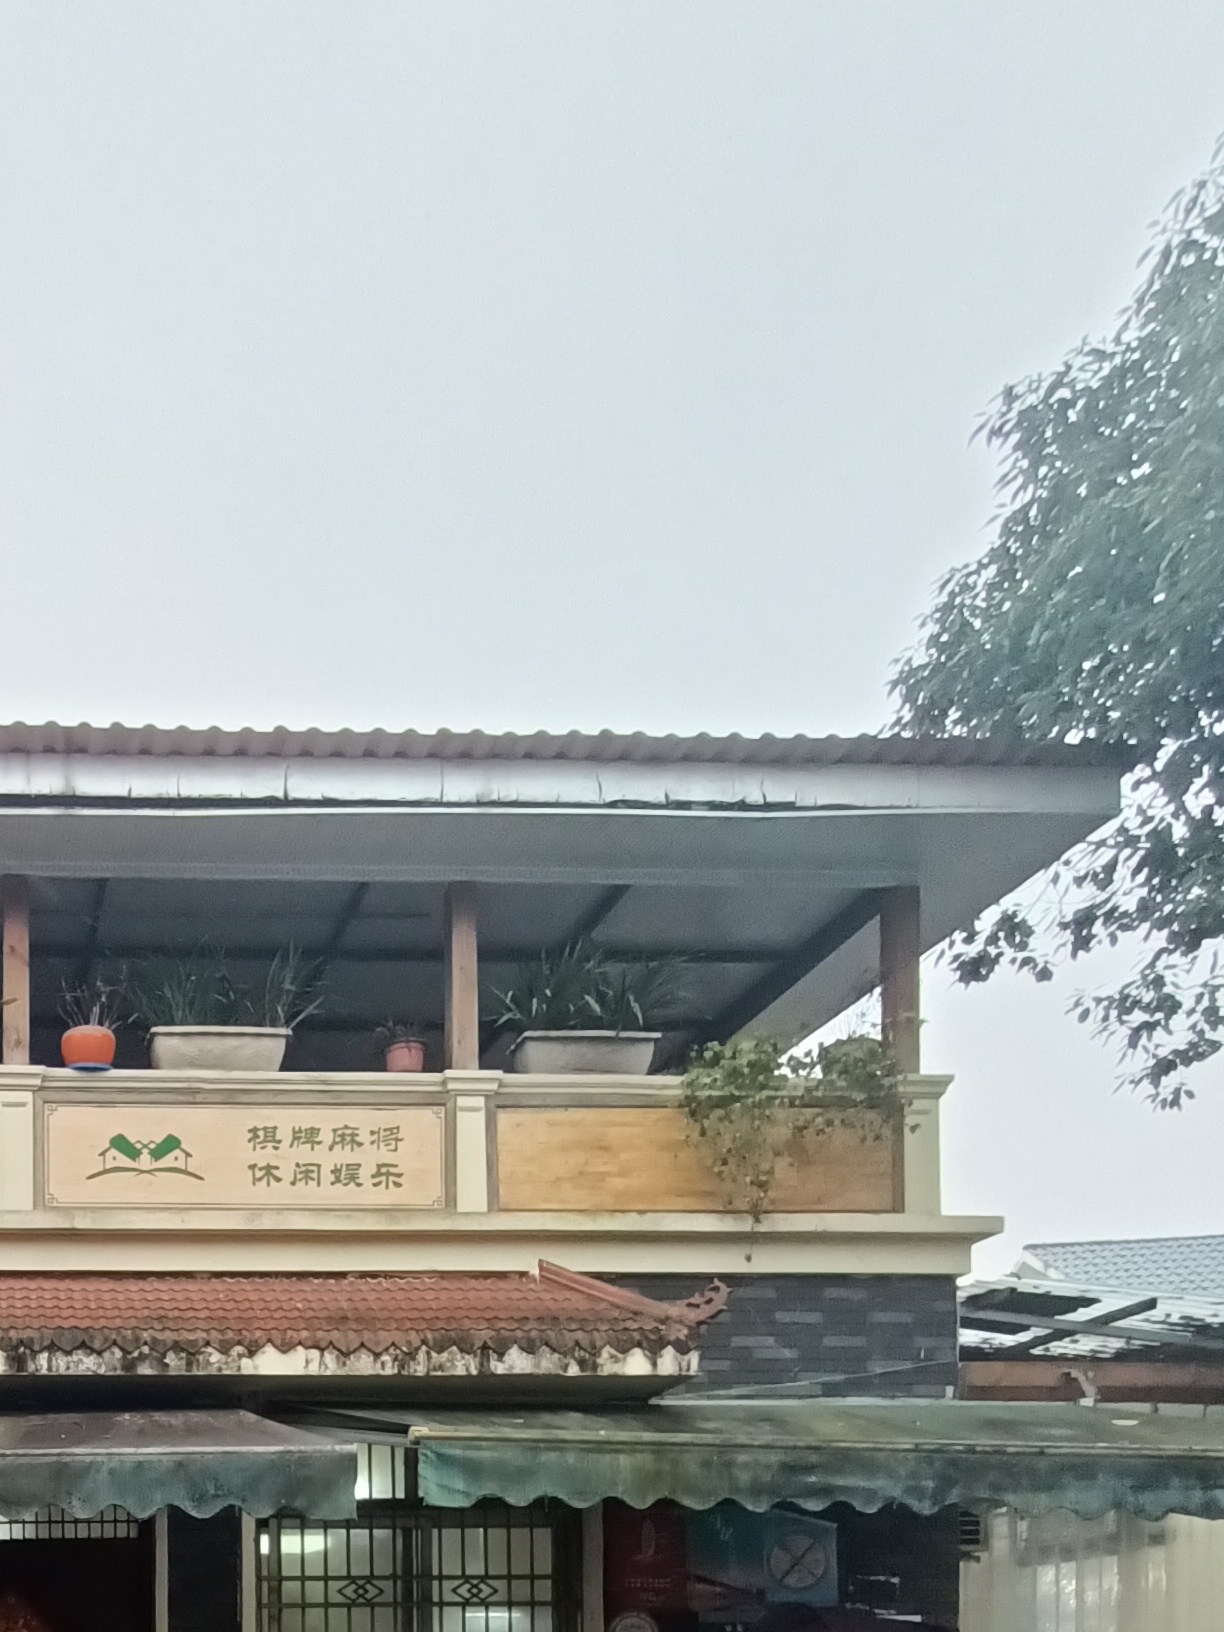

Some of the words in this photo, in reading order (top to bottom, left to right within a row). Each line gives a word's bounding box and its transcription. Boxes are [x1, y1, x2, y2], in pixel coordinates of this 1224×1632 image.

[246, 1124, 405, 1153] 棋牌麻将
[246, 1162, 405, 1190] 休闲娱乐
